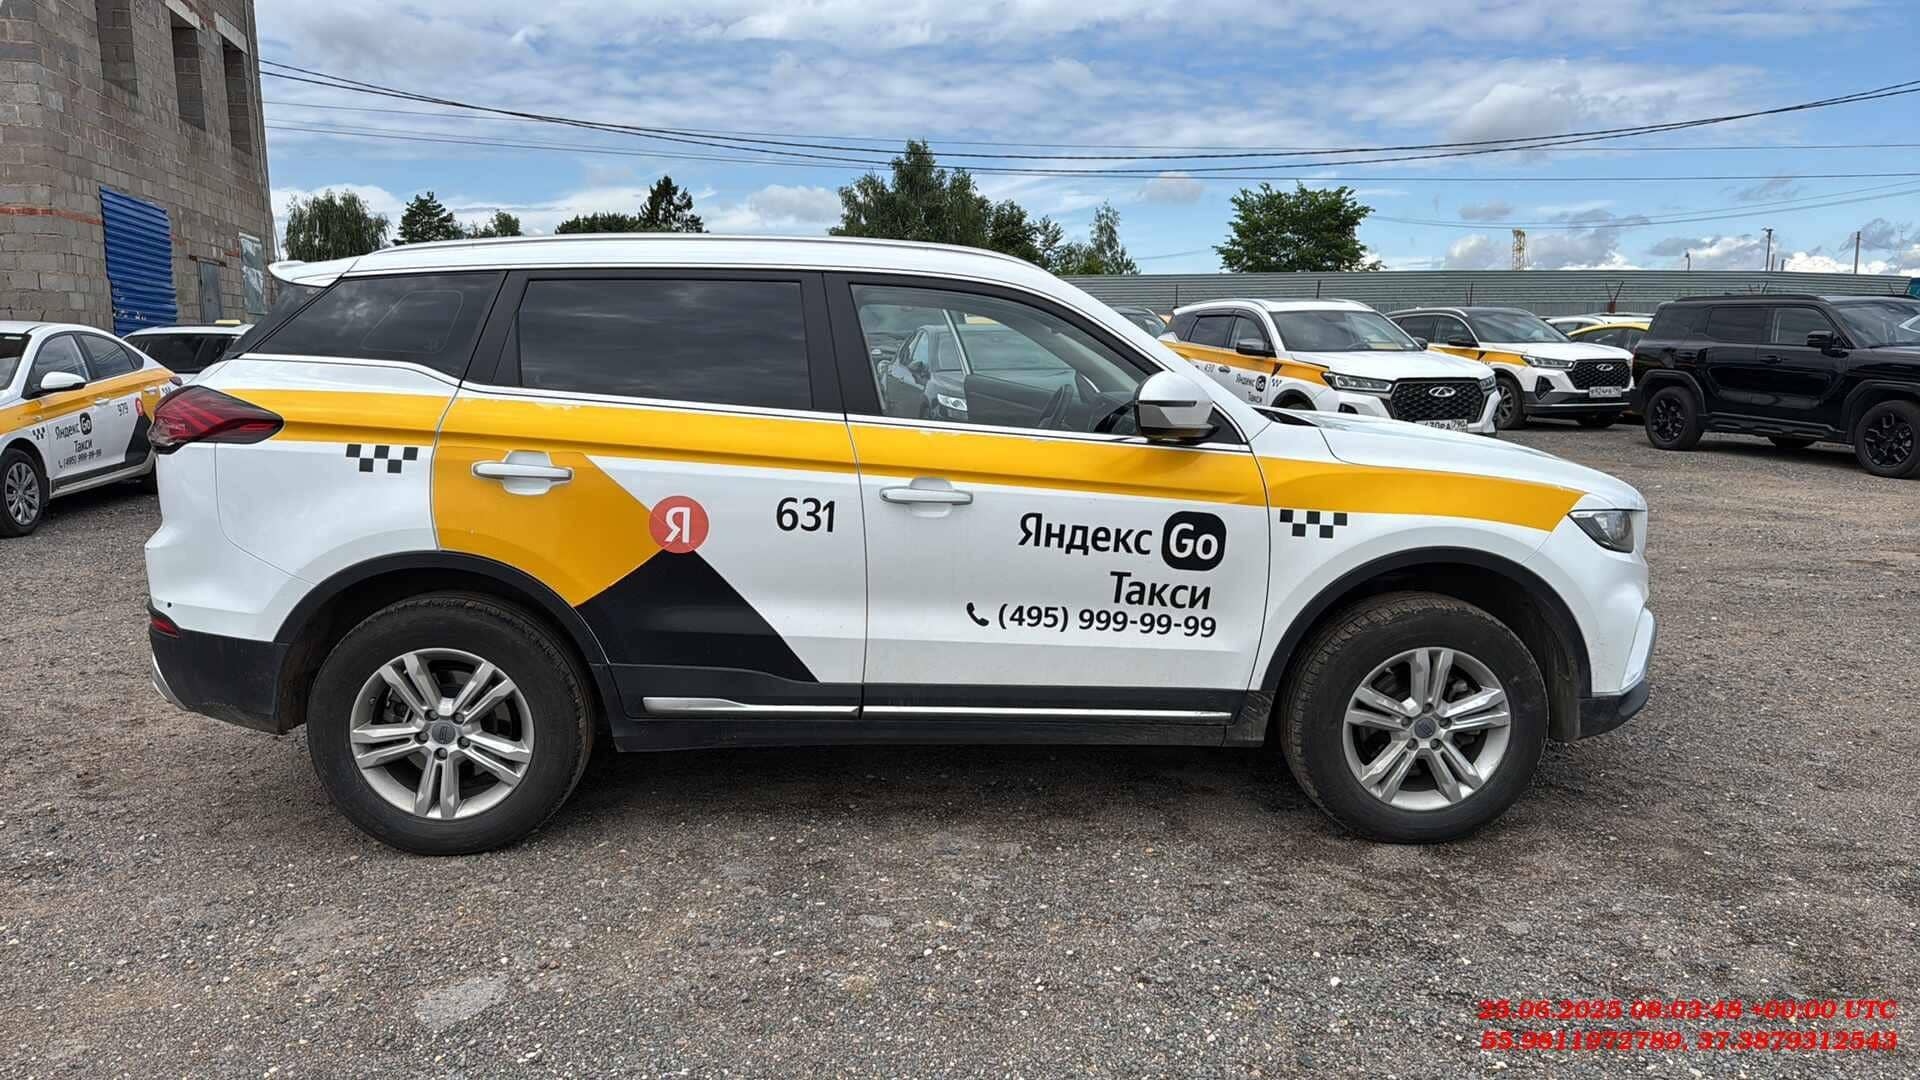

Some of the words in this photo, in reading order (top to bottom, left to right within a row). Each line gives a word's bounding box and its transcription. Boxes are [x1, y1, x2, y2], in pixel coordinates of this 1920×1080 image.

[55, 423, 80, 440] Яндекс
[81, 415, 91, 432] Go
[74, 440, 92, 453] Такси
[664, 506, 691, 544] Я
[776, 496, 835, 533] 631
[1018, 512, 1153, 556] Яндекс
[1167, 520, 1221, 562] Go
[1109, 570, 1211, 610] Такси
[998, 603, 1069, 633] (495)
[1078, 608, 1217, 638] 999-99-99
